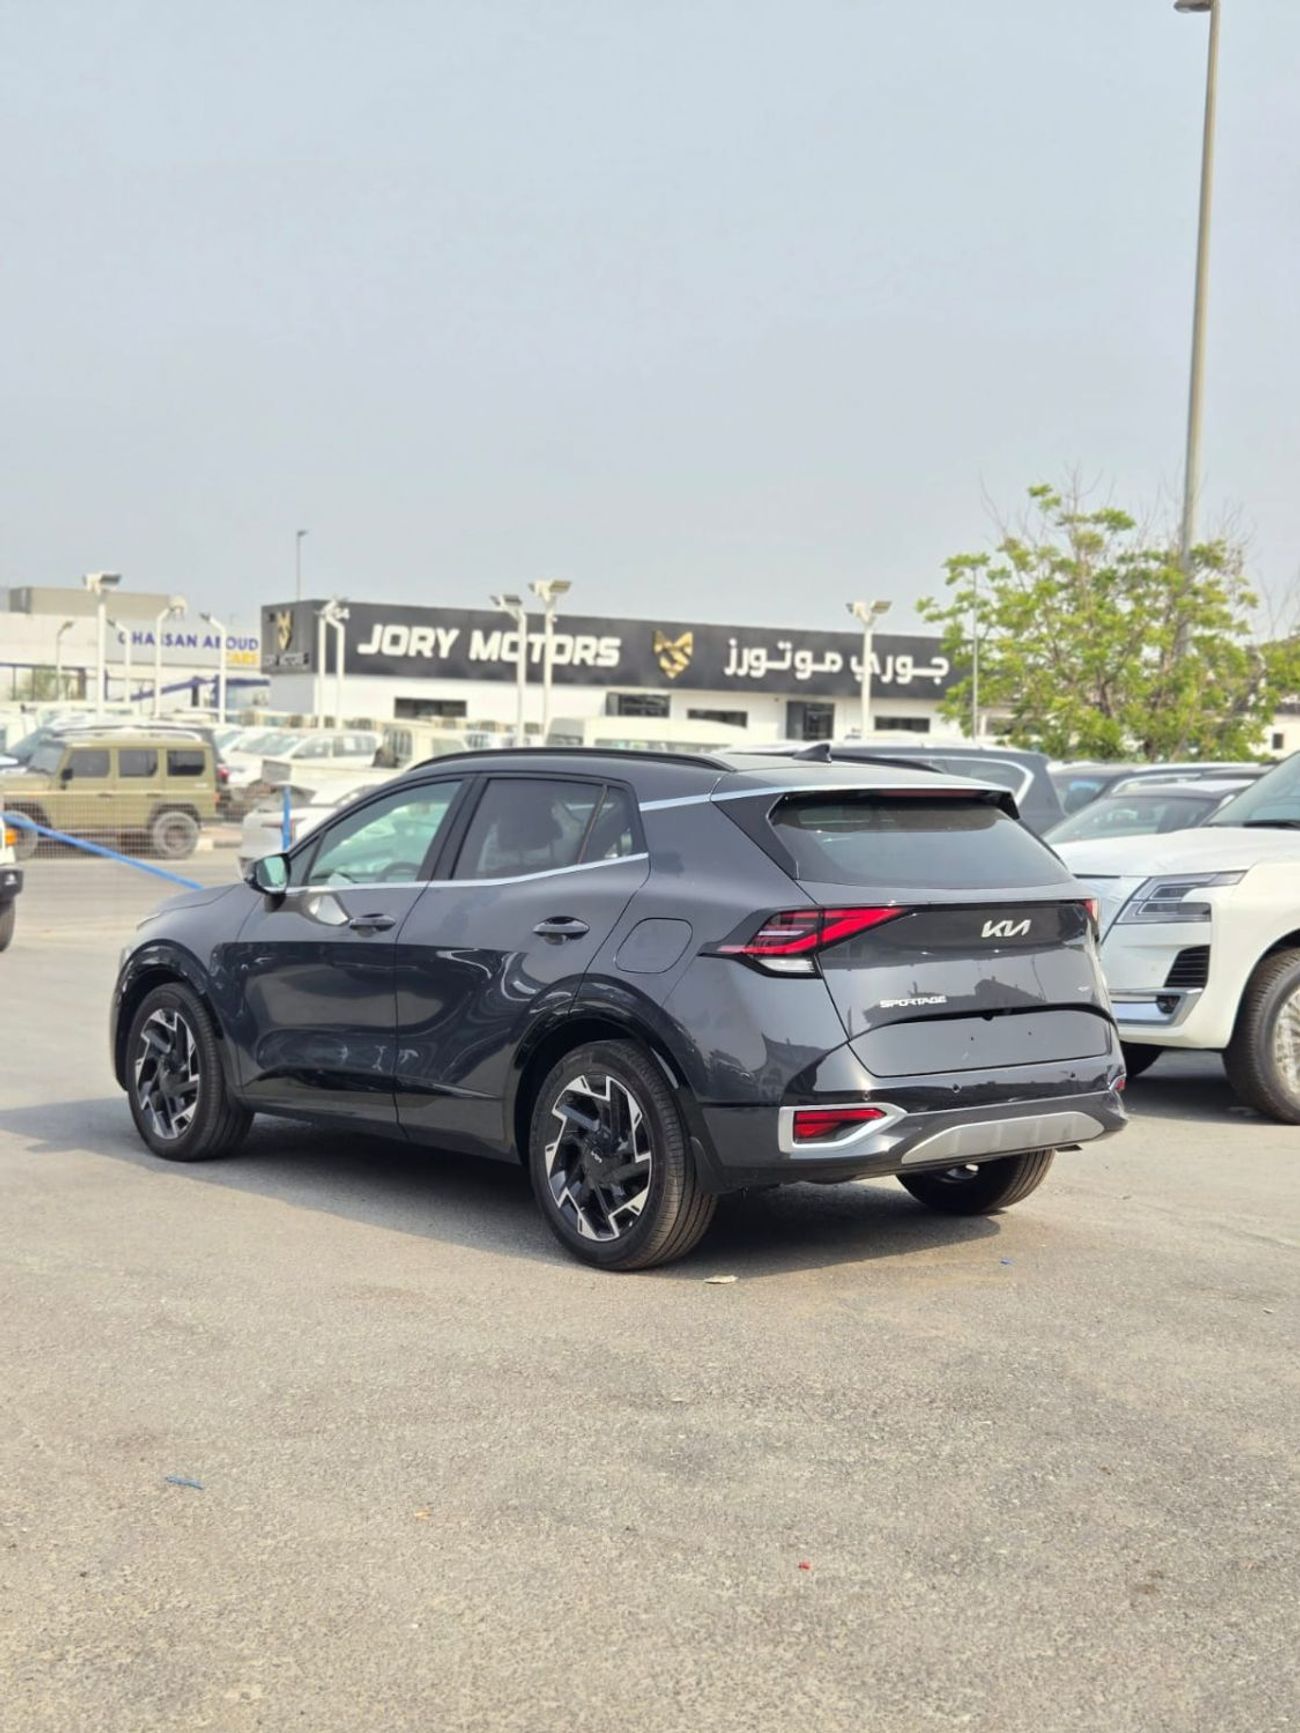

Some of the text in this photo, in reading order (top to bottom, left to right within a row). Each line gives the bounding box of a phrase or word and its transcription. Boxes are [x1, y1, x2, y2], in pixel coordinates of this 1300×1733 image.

[117, 631, 198, 648] GHASAN
[357, 623, 622, 667] JORY MOTORS
[723, 638, 843, 680] موتورز
[981, 919, 1032, 938] KIA
[880, 995, 947, 1008] SPORTAGE
